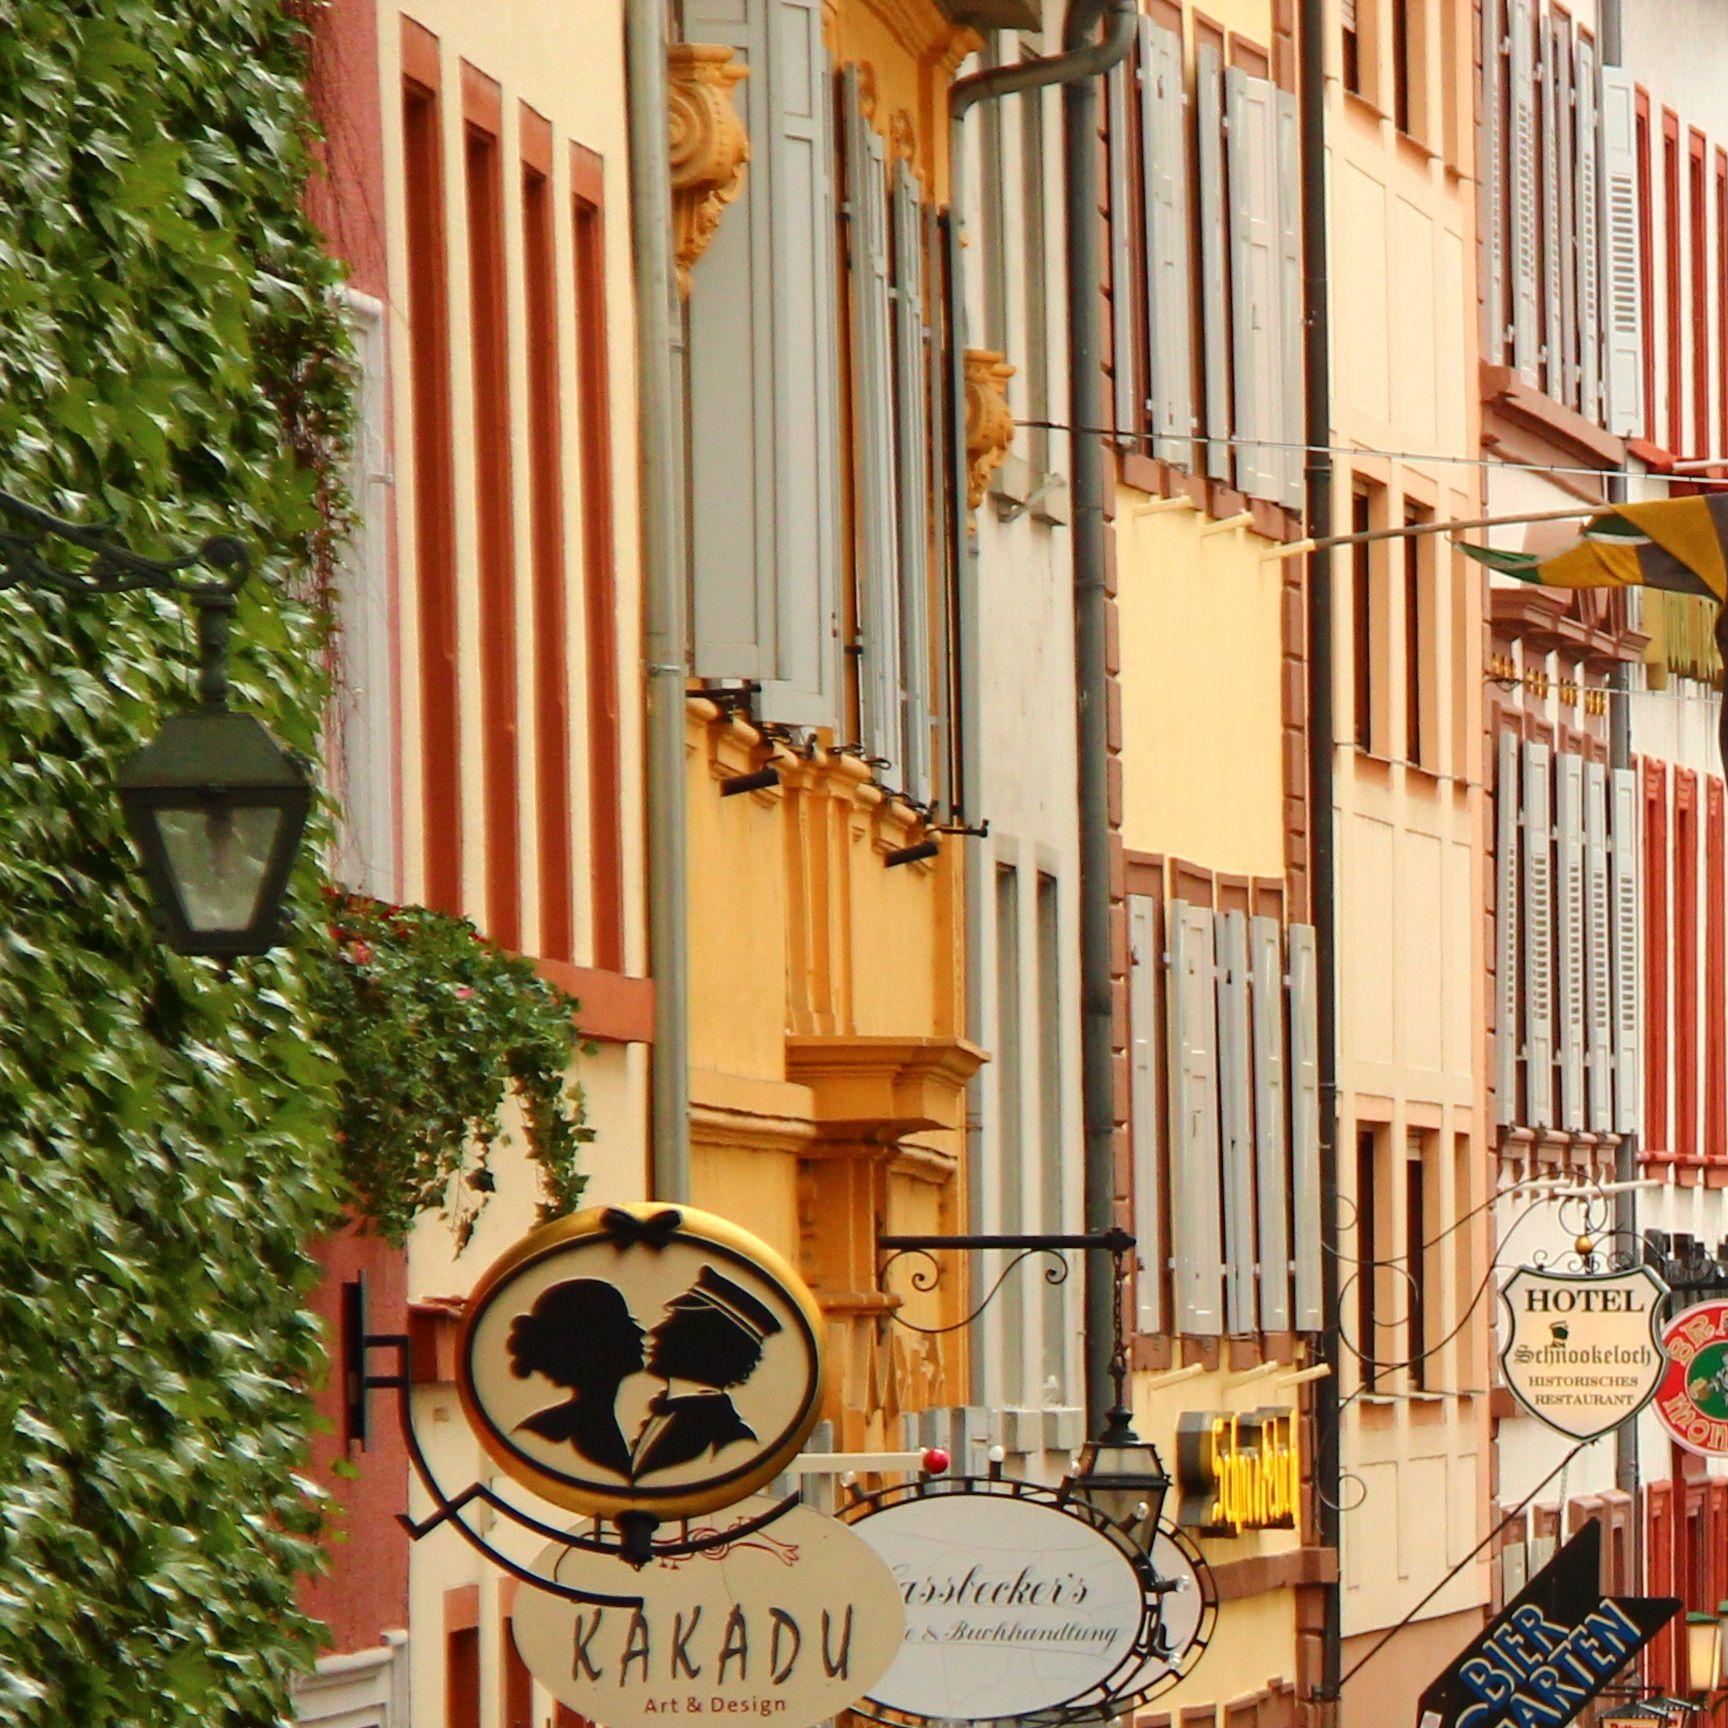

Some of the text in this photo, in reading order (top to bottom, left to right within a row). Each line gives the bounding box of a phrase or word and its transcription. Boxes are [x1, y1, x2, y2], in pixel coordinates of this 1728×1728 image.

[1524, 1288, 1645, 1313] HOTEL
[1513, 1344, 1651, 1367] Schnookeloch
[1528, 1375, 1639, 1388] HISTORISCHES
[1534, 1394, 1634, 1406] RESTAURANT
[892, 1562, 1088, 1606] assbecker's
[570, 1602, 854, 1688] KAKADU
[942, 1619, 1119, 1653] Buchhandlung
[1458, 1603, 1572, 1708] BIER
[644, 1695, 787, 1718] Art & Design
